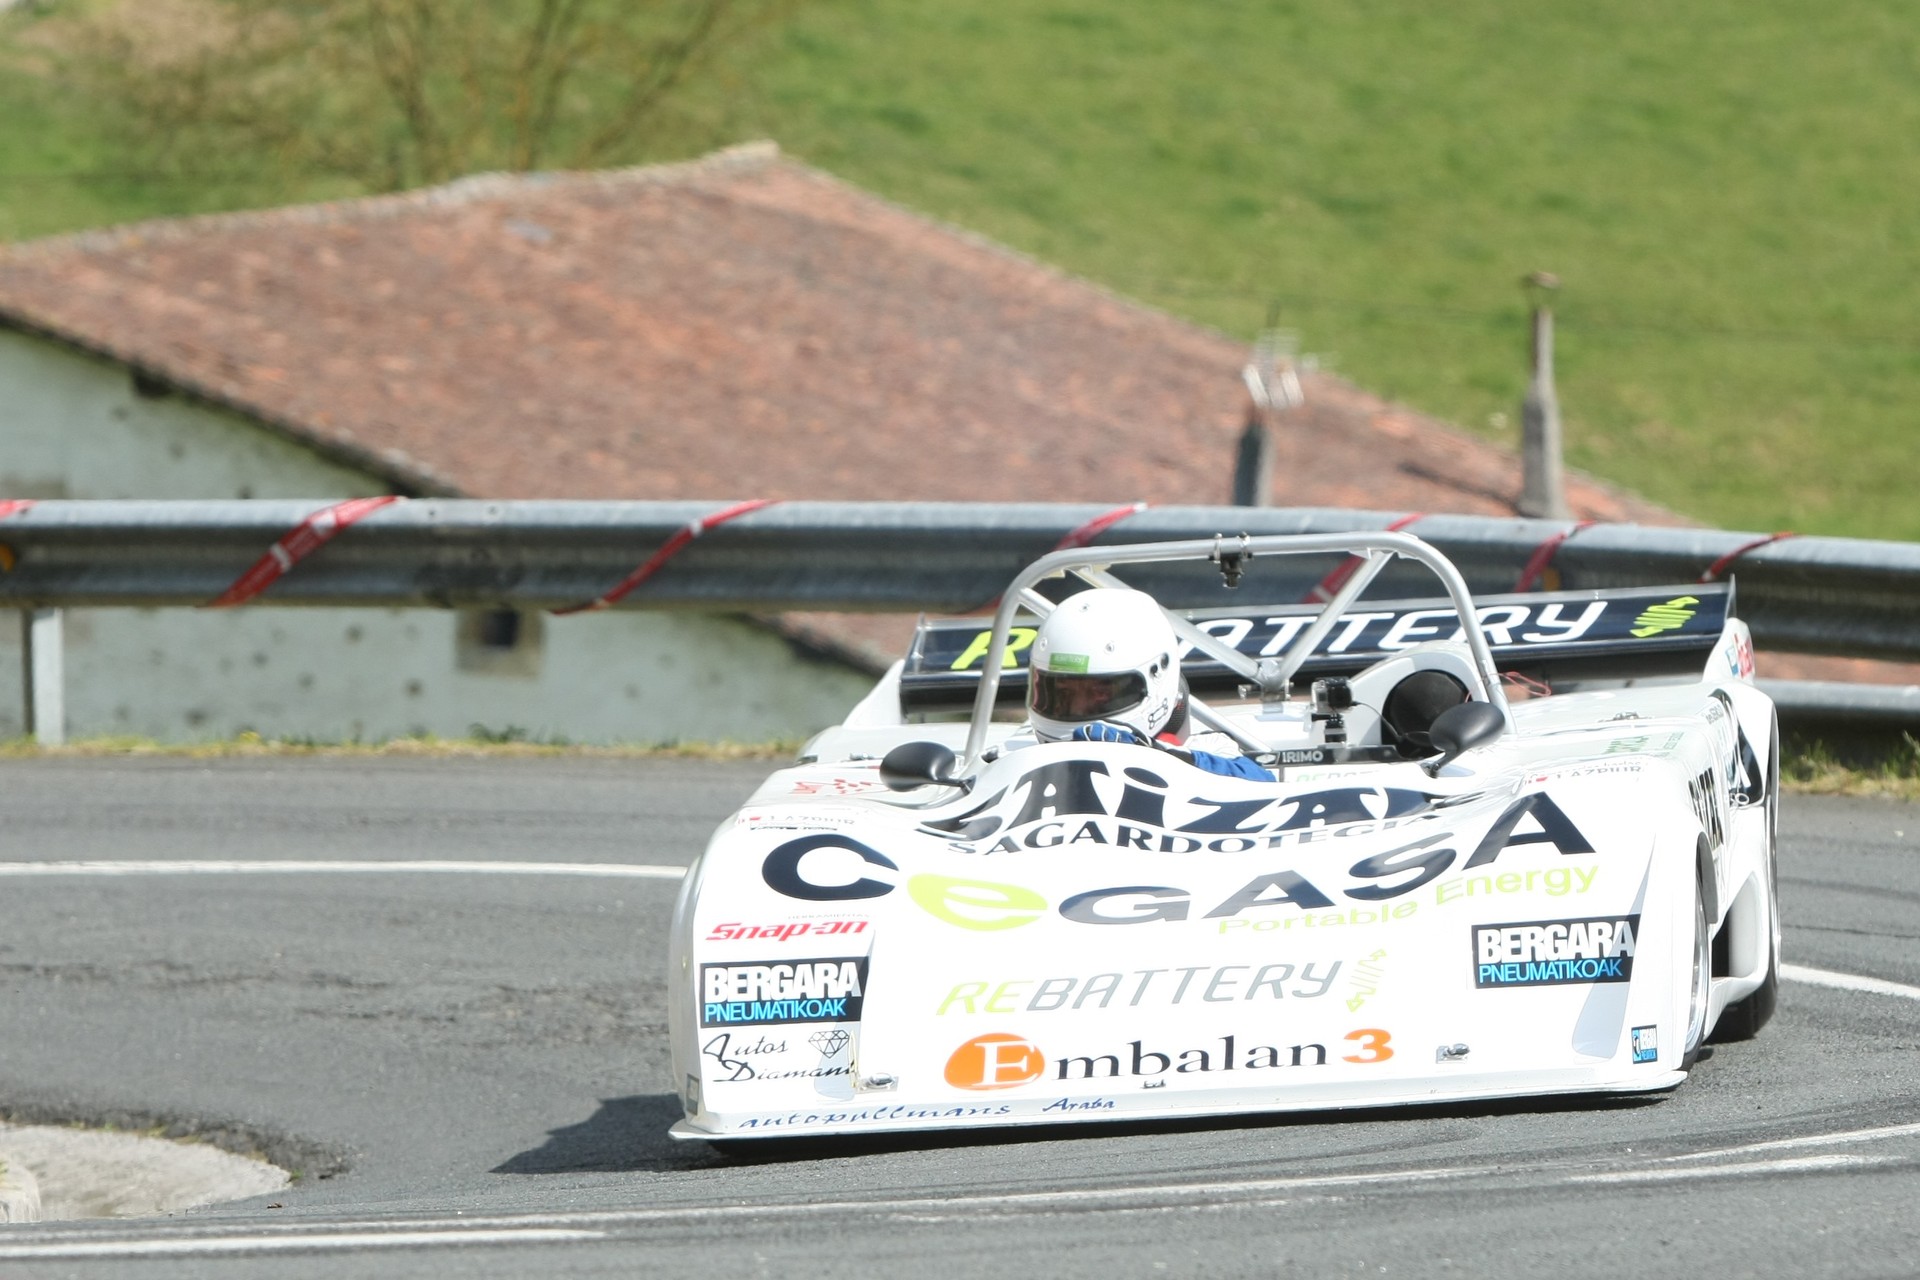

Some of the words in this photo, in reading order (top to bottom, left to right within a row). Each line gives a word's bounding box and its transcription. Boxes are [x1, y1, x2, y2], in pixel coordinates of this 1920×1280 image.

[951, 601, 1607, 670] RATTERY
[1282, 750, 1324, 763] IRIMO
[947, 815, 1443, 857] SAGARDOTEGIA
[1218, 901, 1418, 935] Portable
[1435, 865, 1600, 906] Energy
[705, 920, 869, 942] Snap-on
[1477, 920, 1636, 965] BERGARA
[704, 961, 862, 1004] BERGARA
[936, 960, 1343, 1017] REBATTERY
[1479, 958, 1623, 984] PNEUMATIKOAK
[704, 998, 847, 1023] PNEUMATIKOAK
[702, 1033, 788, 1062] Autos
[972, 1033, 1332, 1088] Embalan
[1341, 1028, 1395, 1064] 3
[737, 1104, 1012, 1130] autopullmans
[1041, 1096, 1116, 1114] Araba
